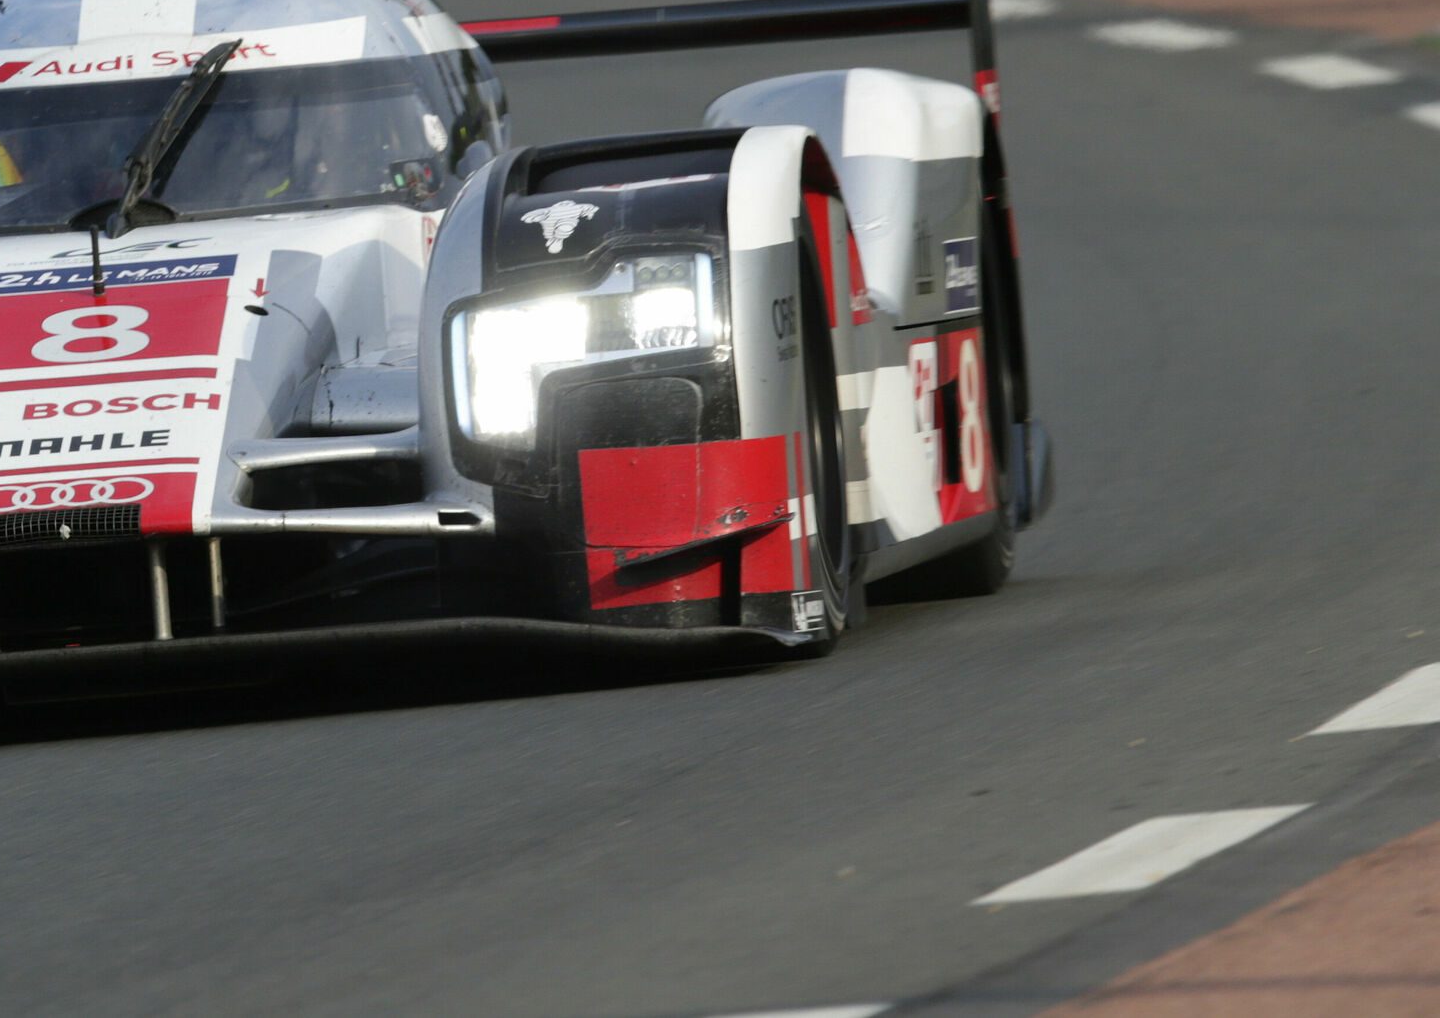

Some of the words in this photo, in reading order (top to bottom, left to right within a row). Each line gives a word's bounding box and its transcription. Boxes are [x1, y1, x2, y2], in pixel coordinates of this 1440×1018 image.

[32, 54, 134, 77] Audi
[152, 44, 278, 68] Sprt
[116, 262, 220, 279] MANS
[31, 304, 150, 364] 8
[22, 392, 222, 421] BOSCH
[959, 338, 985, 493] 8
